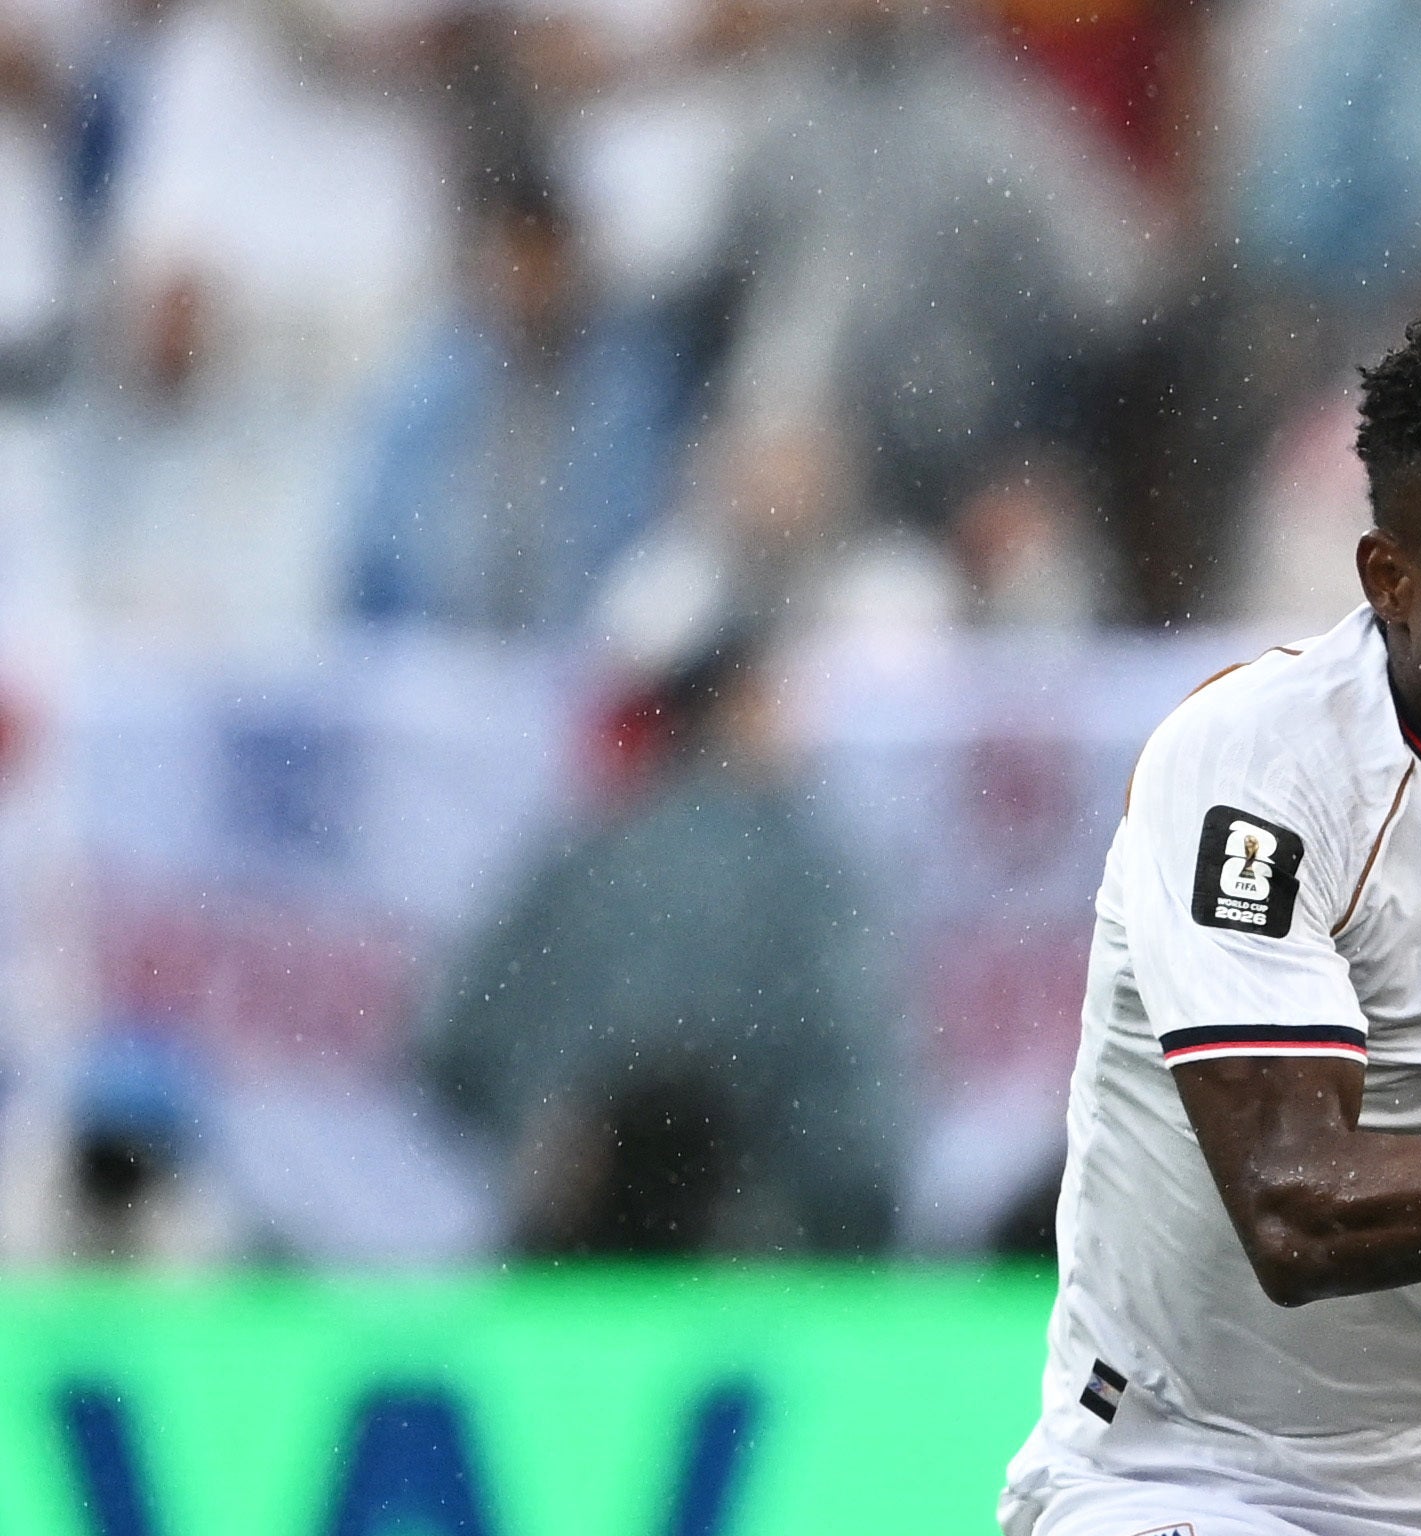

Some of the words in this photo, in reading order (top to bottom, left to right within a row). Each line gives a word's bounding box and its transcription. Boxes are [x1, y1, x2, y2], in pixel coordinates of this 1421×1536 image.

[1234, 881, 1257, 893] FIFA
[1217, 897, 1250, 910] WORLD
[1250, 903, 1269, 913] CUP
[1214, 905, 1268, 926] 2026
